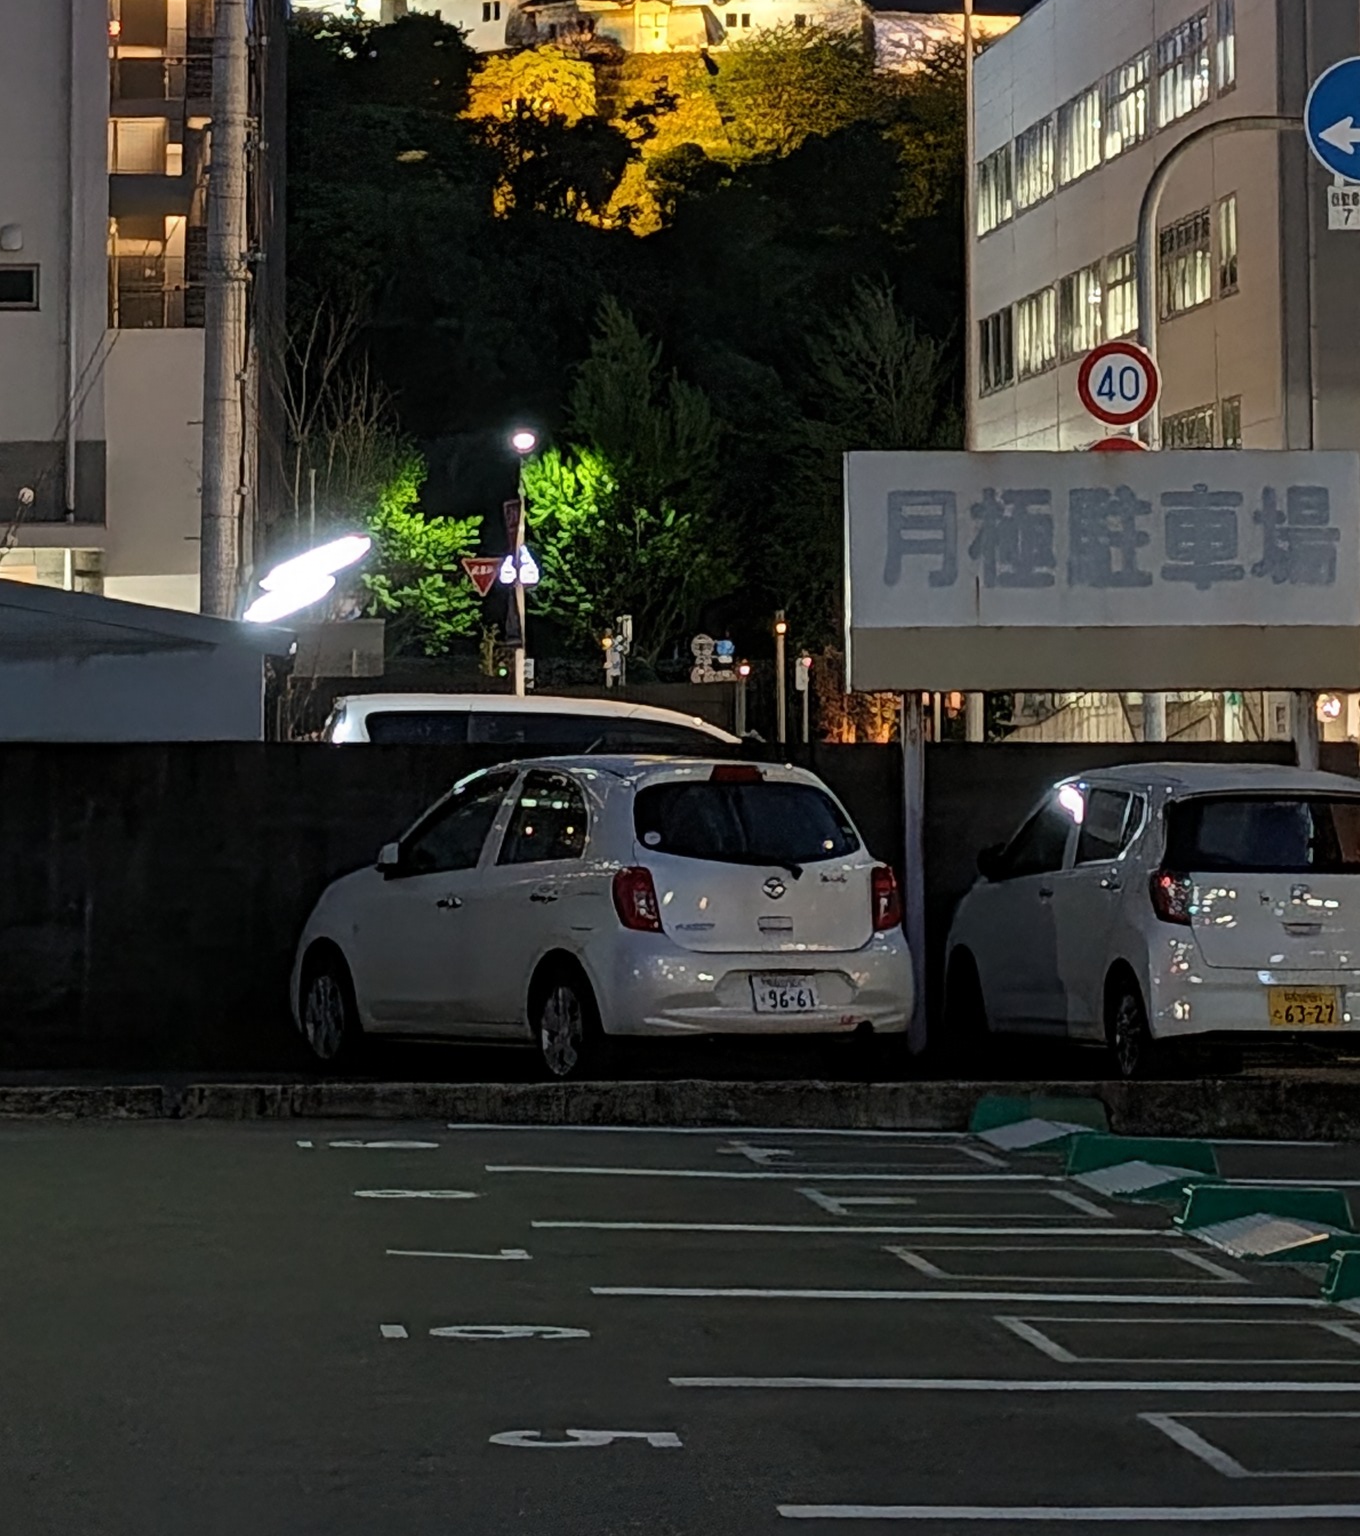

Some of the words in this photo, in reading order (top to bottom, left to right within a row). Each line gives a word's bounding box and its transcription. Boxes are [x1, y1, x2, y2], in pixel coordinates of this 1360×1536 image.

[1096, 364, 1140, 402] 40
[881, 483, 1341, 590] 月極駐車場
[488, 1428, 684, 1448] 5
